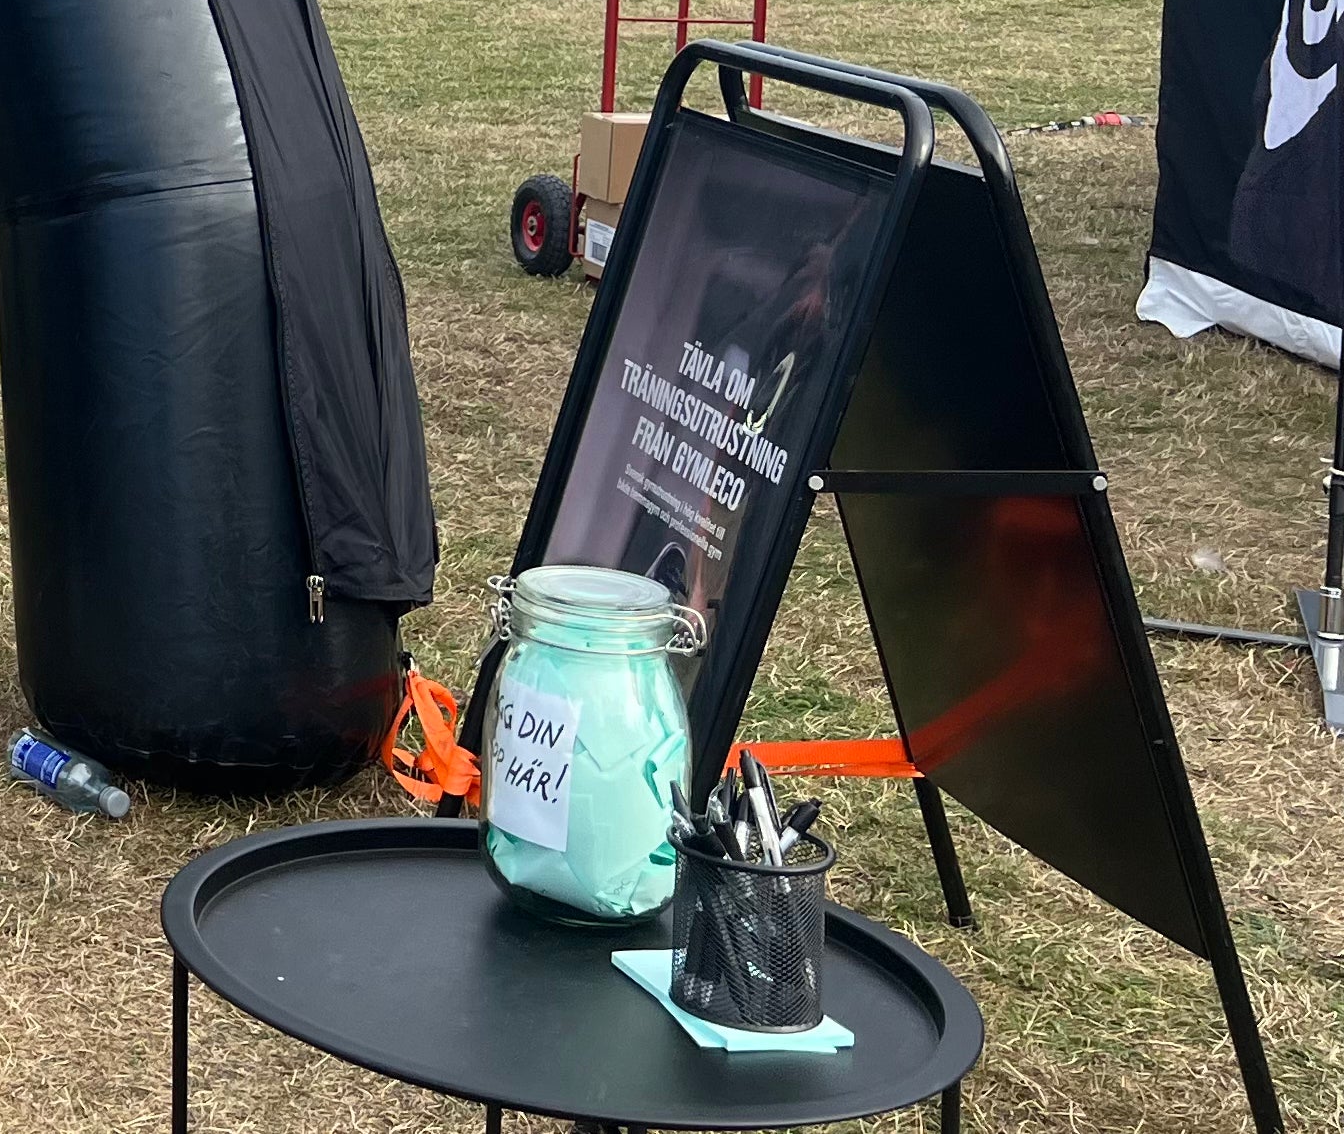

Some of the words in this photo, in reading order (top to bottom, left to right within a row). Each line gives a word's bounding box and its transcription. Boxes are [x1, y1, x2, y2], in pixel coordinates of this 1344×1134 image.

[678, 340, 725, 394] TÄVLA
[725, 368, 756, 409] OM
[620, 358, 788, 485] TRÄNINGSUTRUSTNING
[631, 415, 676, 465] FRÅN
[671, 441, 746, 511] GYMLECO
[518, 710, 564, 749] DIN
[504, 756, 569, 804] HÄR!
